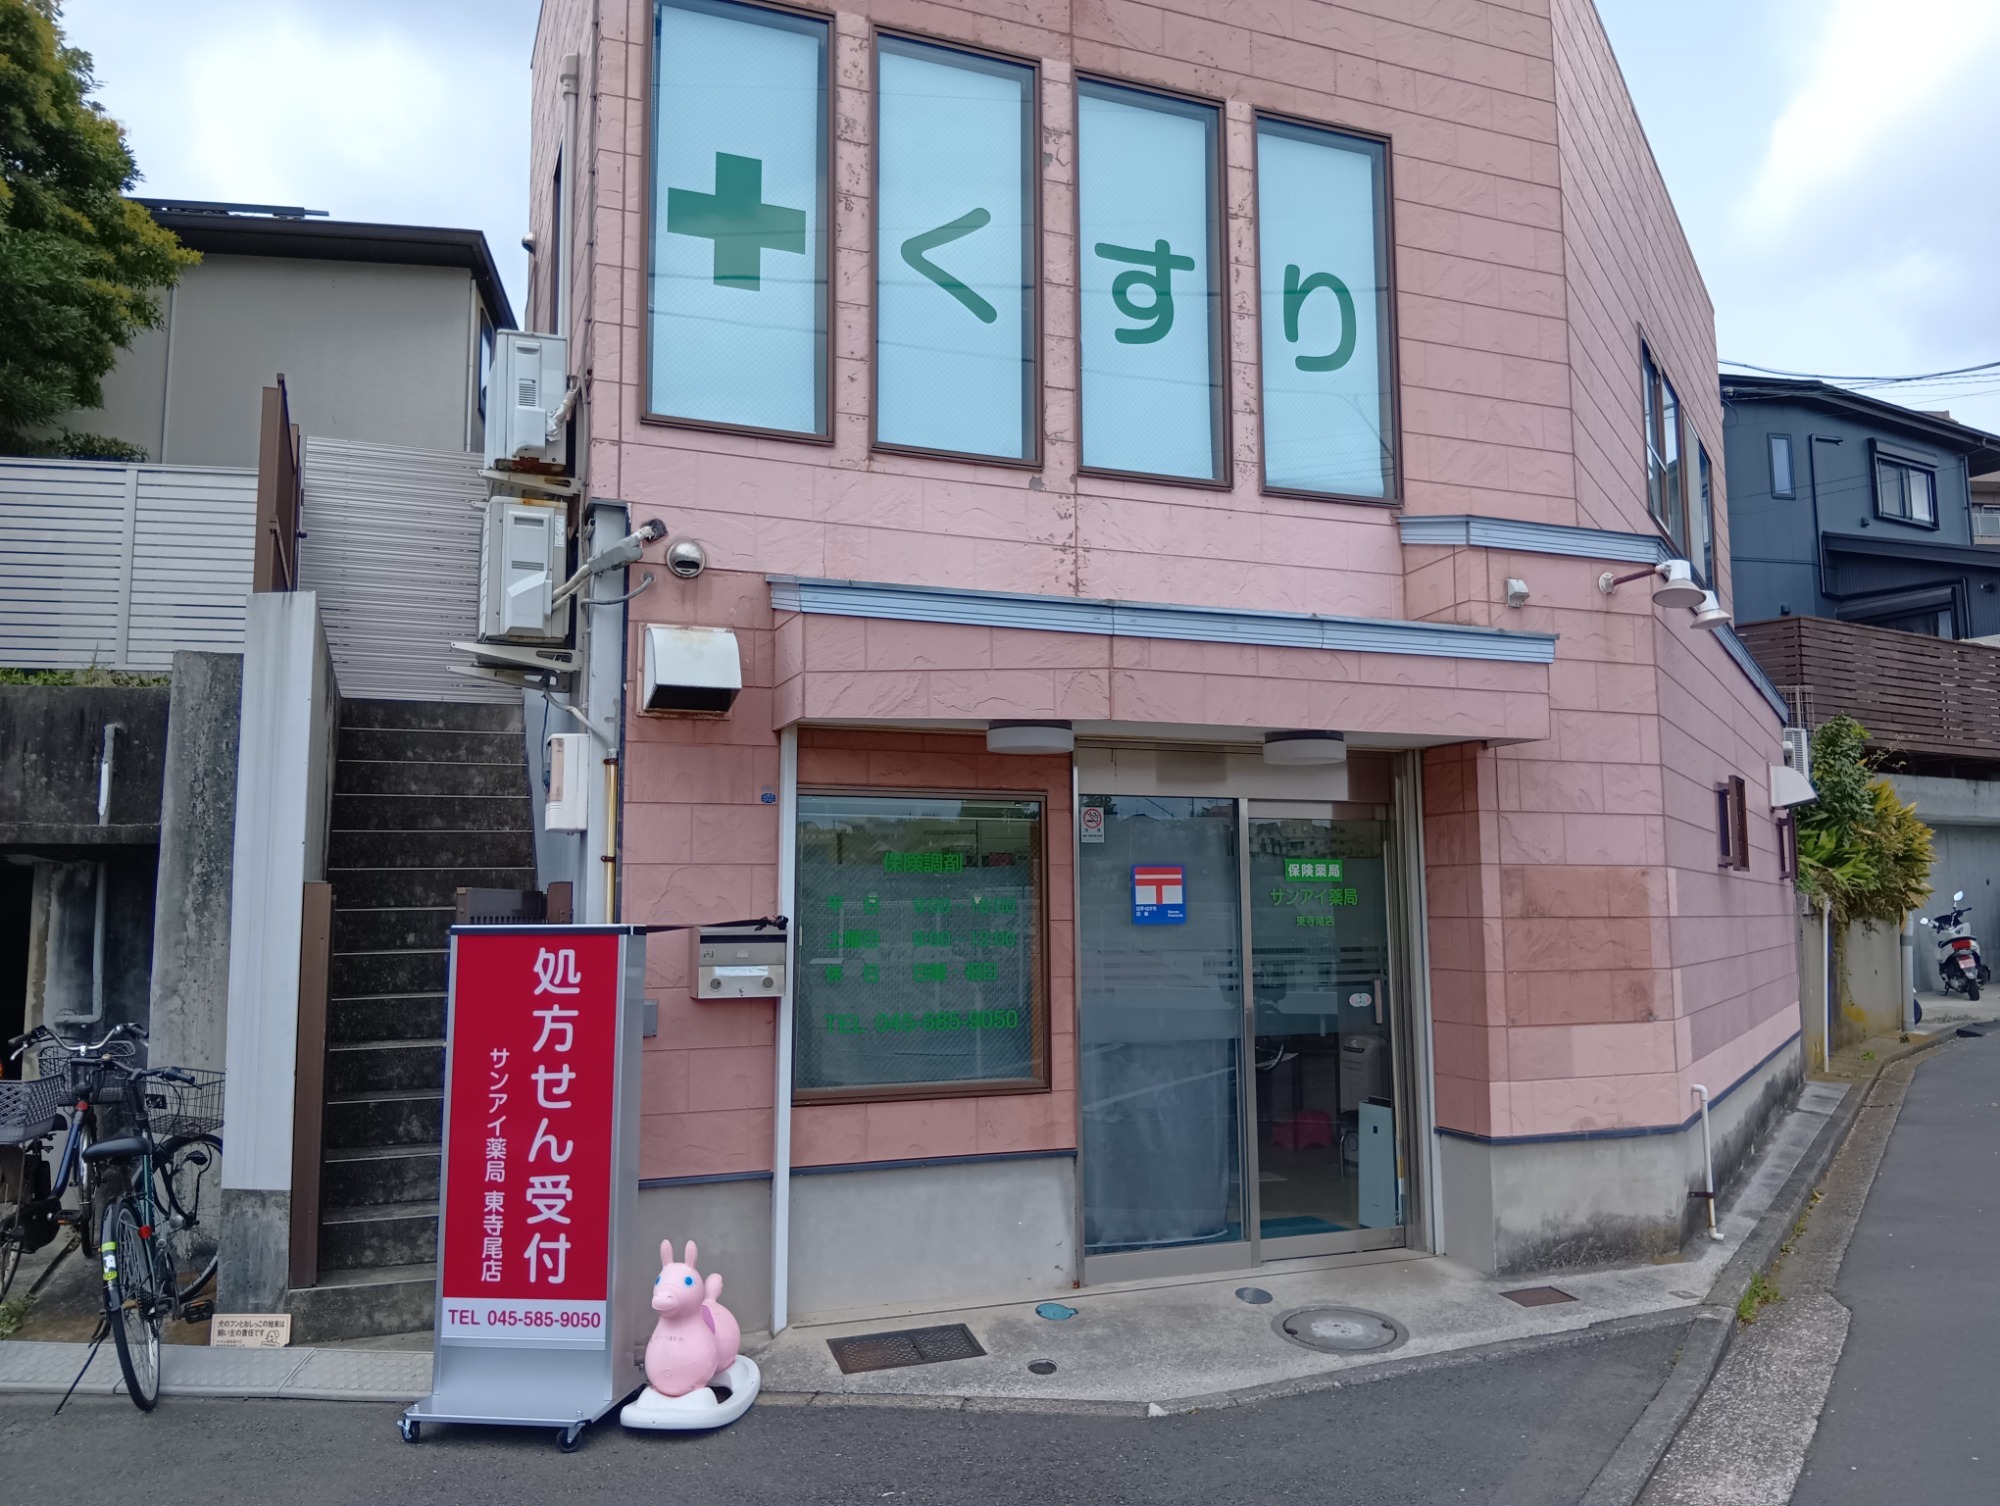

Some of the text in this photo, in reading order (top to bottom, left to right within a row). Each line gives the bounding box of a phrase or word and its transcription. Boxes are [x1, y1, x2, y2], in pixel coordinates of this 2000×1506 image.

[901, 207, 1357, 372] くすり
[884, 851, 963, 874] 保険調剤
[1288, 863, 1340, 877] 保険薬局
[1270, 888, 1358, 906] サンアイ薬局
[1296, 916, 1335, 927] 東寺尾店
[825, 1010, 1018, 1034] TEL 045-585-9050
[523, 947, 581, 1284] 処方せん受付
[481, 1048, 510, 1282] サンアイ薬局 東寺尾店
[448, 1309, 601, 1328] TEL 045-585-9050
